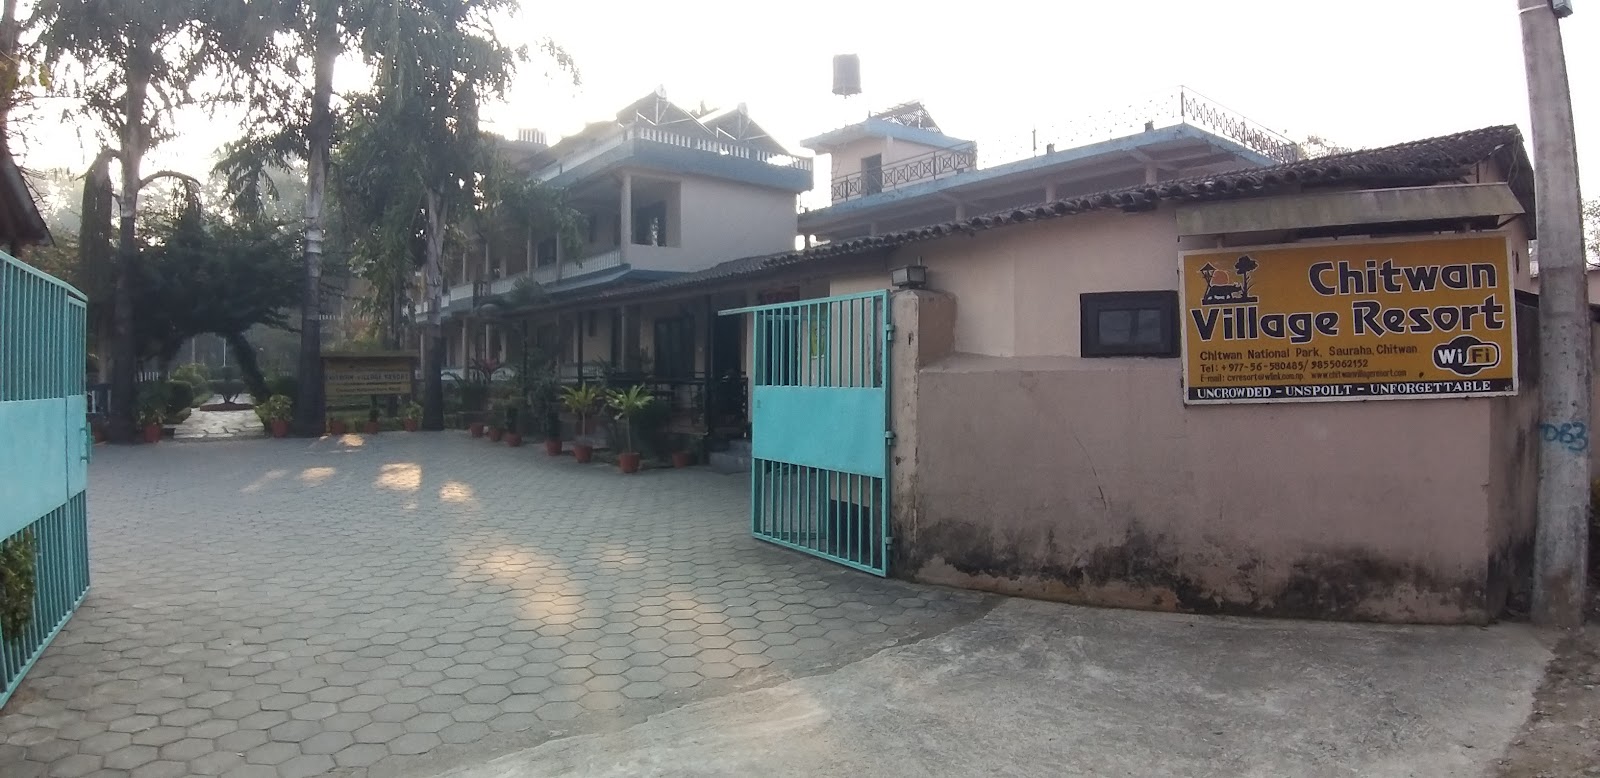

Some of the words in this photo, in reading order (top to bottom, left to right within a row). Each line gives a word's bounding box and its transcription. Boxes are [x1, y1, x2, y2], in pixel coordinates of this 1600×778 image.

[1308, 259, 1497, 296] Chitwan
[1191, 305, 1339, 345] Village
[1352, 295, 1504, 338] Resort
[1200, 351, 1243, 361] Chitwan
[1247, 349, 1290, 360] National
[1376, 344, 1418, 355] Chitwan
[1197, 386, 1272, 399] UNCROWDED
[1285, 384, 1352, 397] UNSPOILT
[1370, 380, 1491, 394] UNFORGETTABLE
